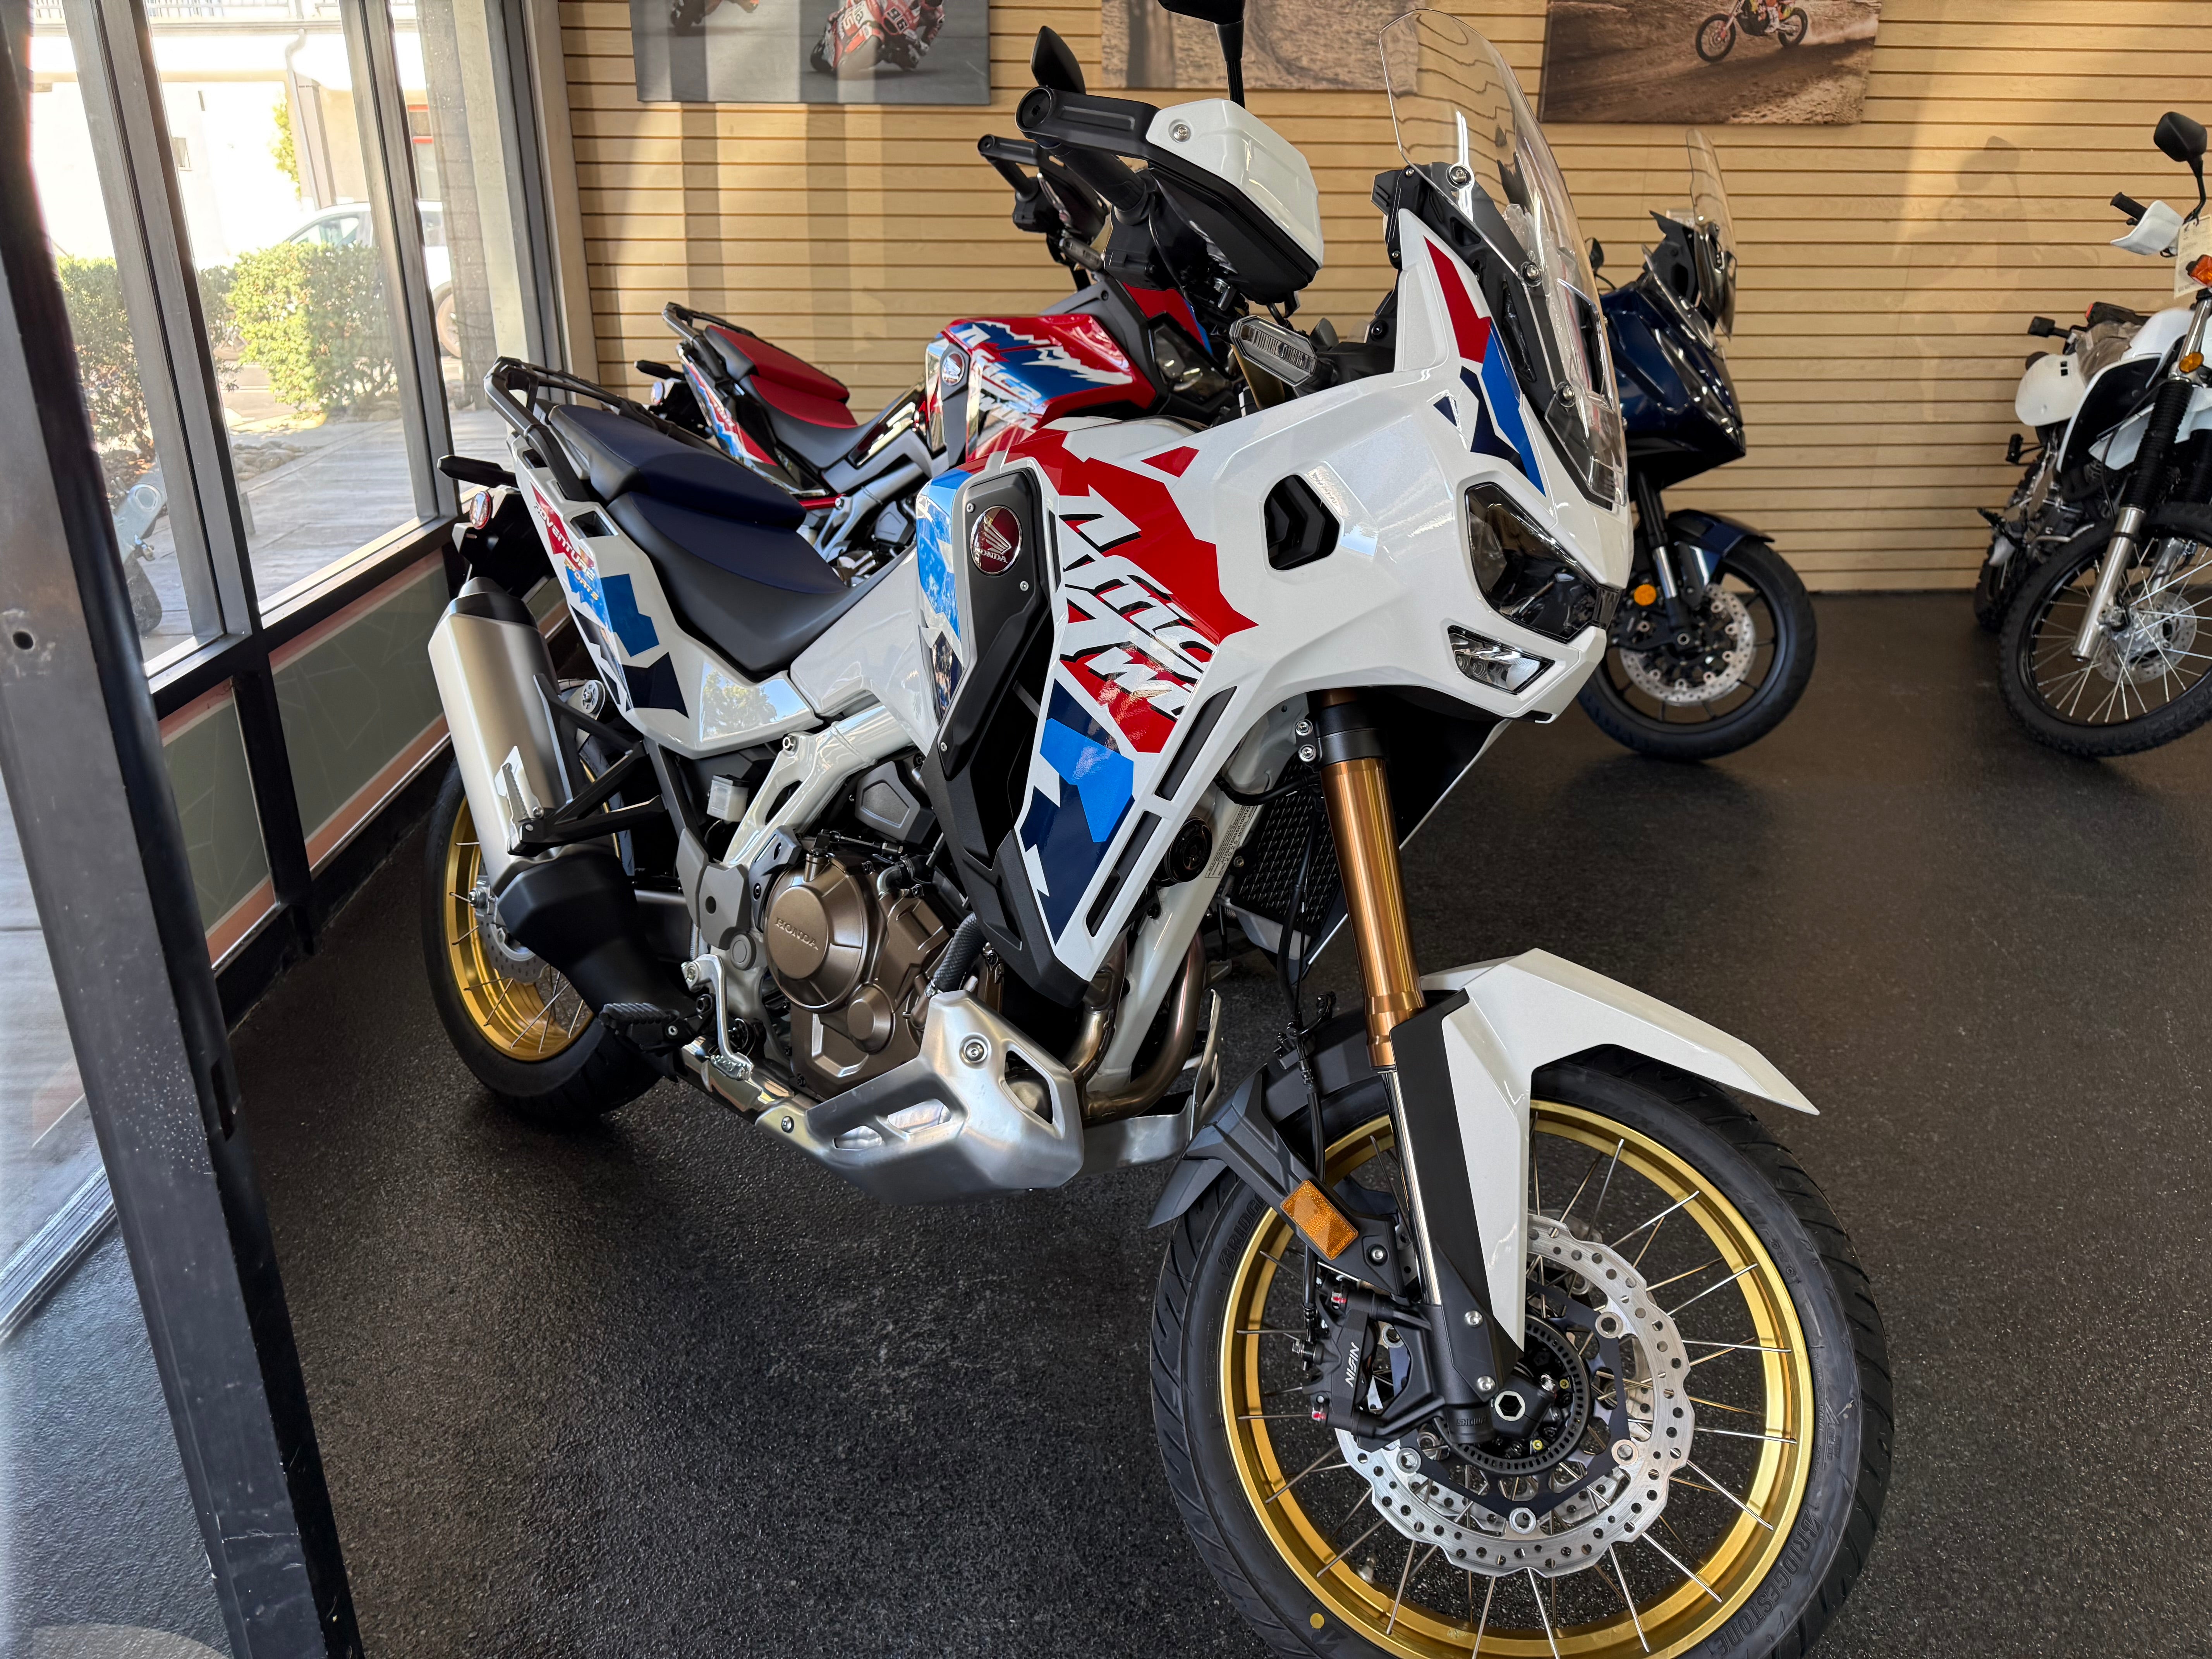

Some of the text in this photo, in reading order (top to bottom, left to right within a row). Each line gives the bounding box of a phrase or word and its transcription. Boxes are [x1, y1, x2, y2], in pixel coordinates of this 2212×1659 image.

[887, 7, 908, 31] 96
[534, 502, 596, 581] ADVENTURE
[564, 558, 599, 601] SPORTS
[1058, 484, 1217, 680] Afric
[1059, 583, 1204, 720] Twi
[775, 917, 818, 950] HONDA
[1714, 1509, 1822, 1657] BRIDGESTONE
